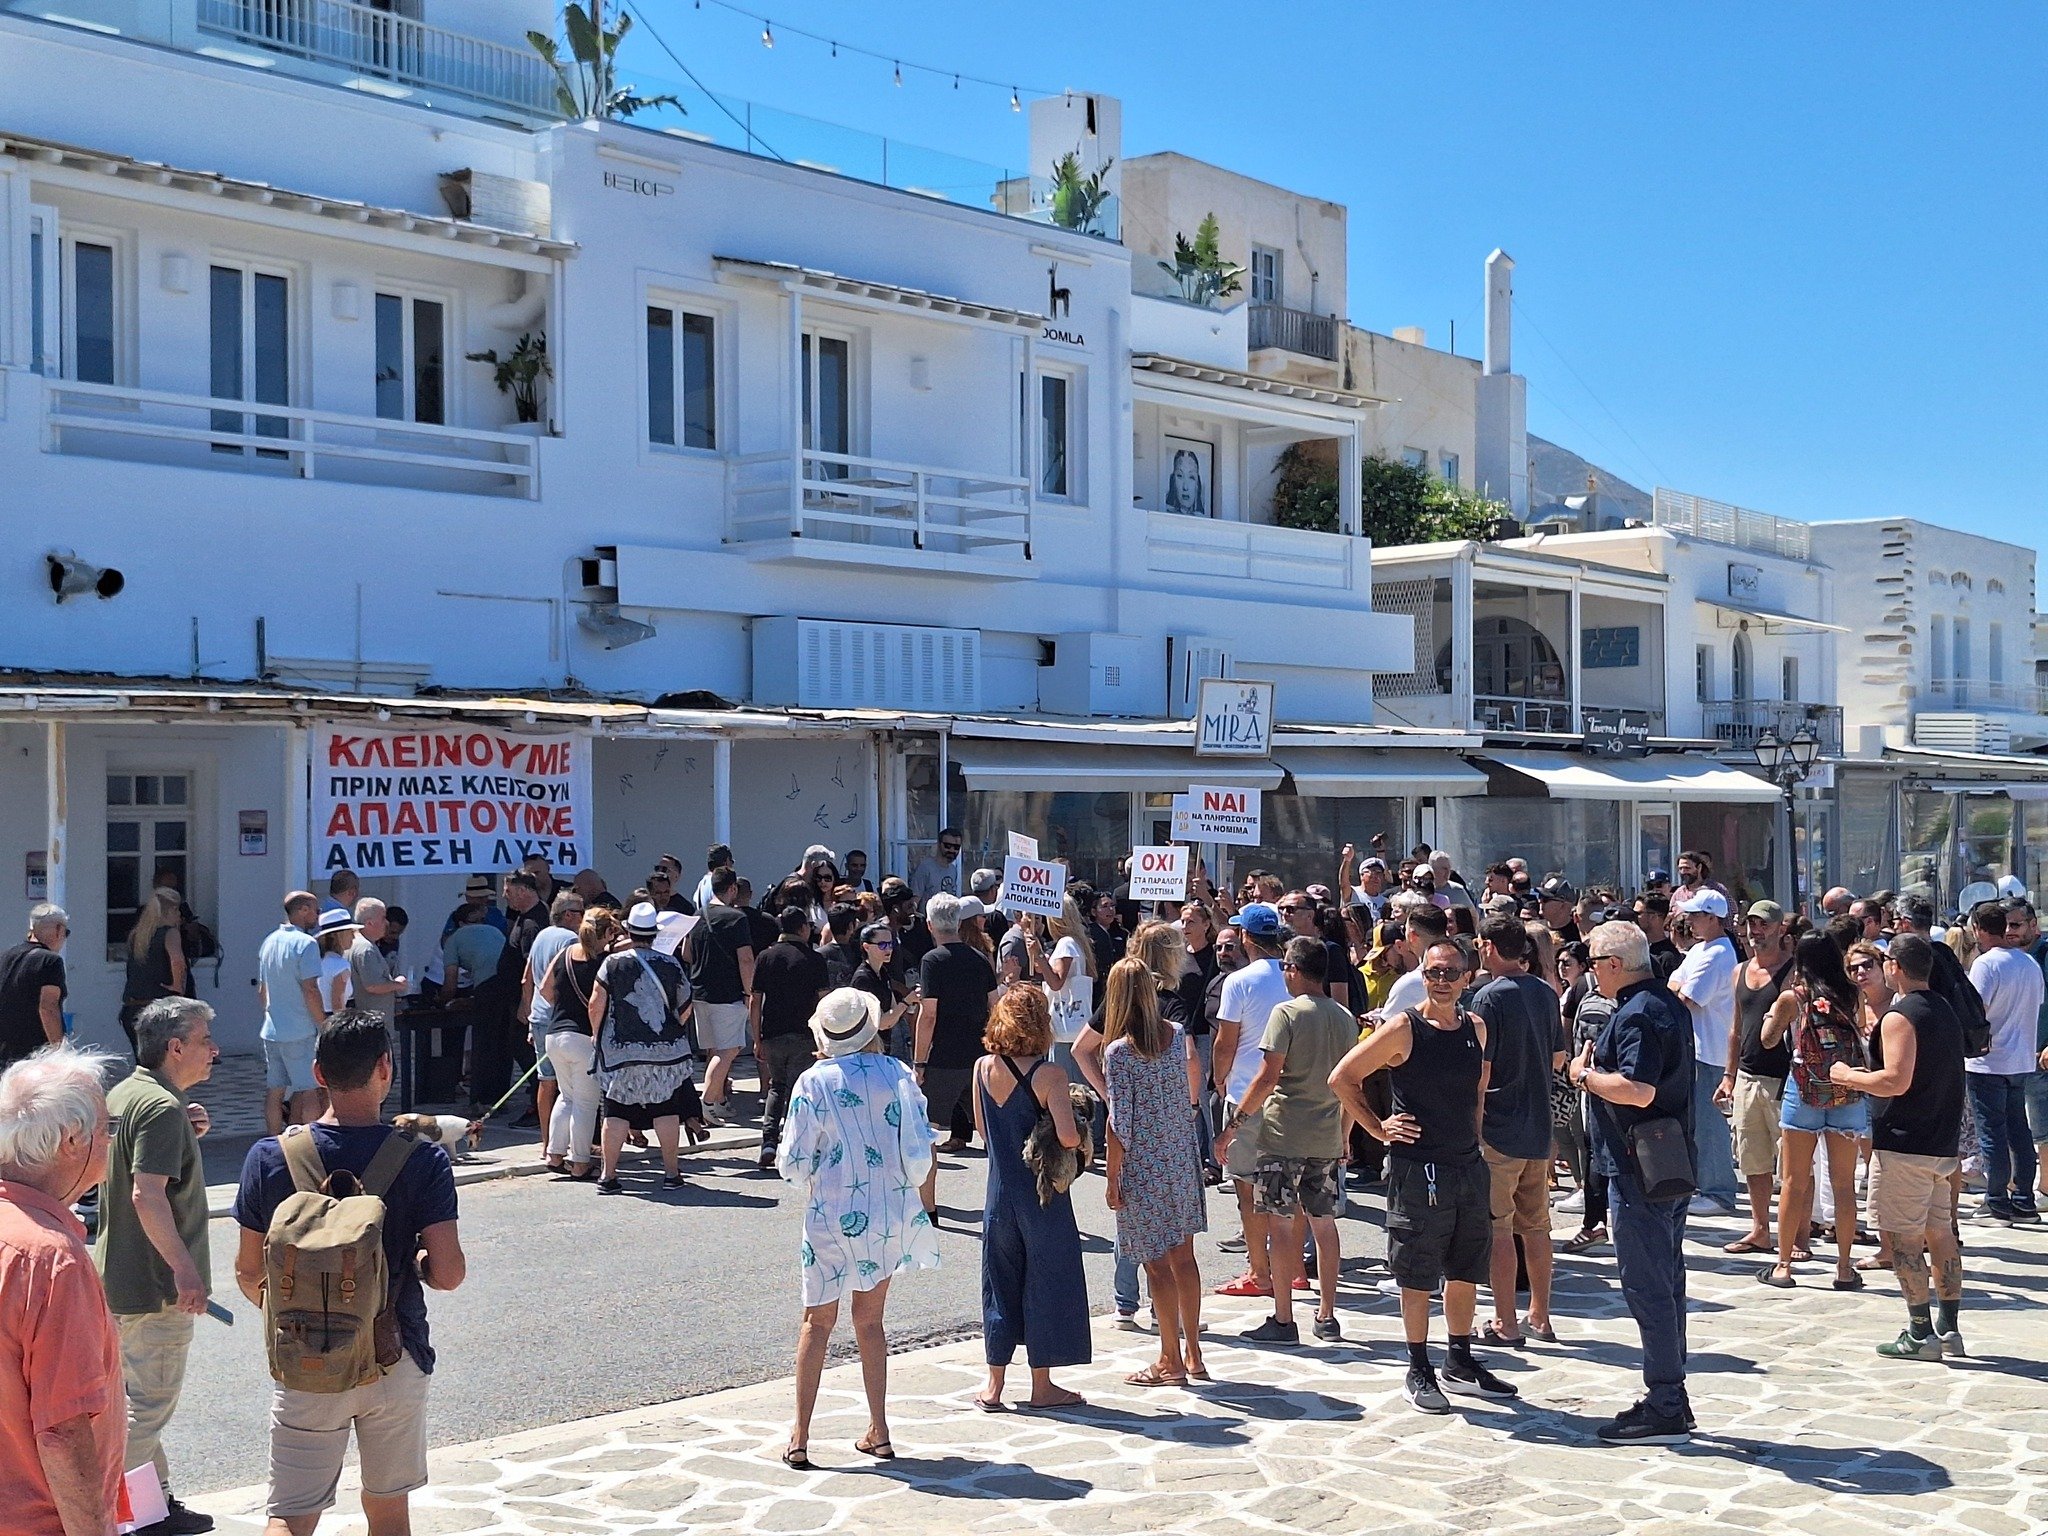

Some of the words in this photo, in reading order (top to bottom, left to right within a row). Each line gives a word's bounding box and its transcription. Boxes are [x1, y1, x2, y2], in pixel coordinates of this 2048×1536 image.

[328, 733, 571, 776] ΚΛΕΙΝΟΥΜΕ
[330, 776, 392, 797] ΠΡΙΝ
[398, 775, 455, 796] ΜΑΣ
[461, 775, 570, 802] ΚΛΕΙΣΟΥΝ
[1204, 791, 1245, 813] ΝΑΙ
[326, 800, 575, 837] ΑΠΑΙΤΟΥΜΕ
[1204, 813, 1258, 824] ΠΛΗΡΩΣΟΥΜΕ
[1200, 823, 1212, 832] ΤΑ
[1213, 825, 1249, 834] ΝΟΜΙΜΑ
[325, 839, 473, 870] ΑΜΕΣΗ
[1142, 853, 1174, 871] ΟΧΙ
[1018, 866, 1050, 886] ΟΧΙ
[1148, 877, 1183, 885] ΠΑΡΑΛΟΓΑ
[1010, 883, 1033, 893] ΣΤΟΝ
[1140, 887, 1174, 895] ΠΡΟΣΤΙΜΑ
[1004, 892, 1061, 910] ΑΠΟΚΛΕΙΣΜΟ
